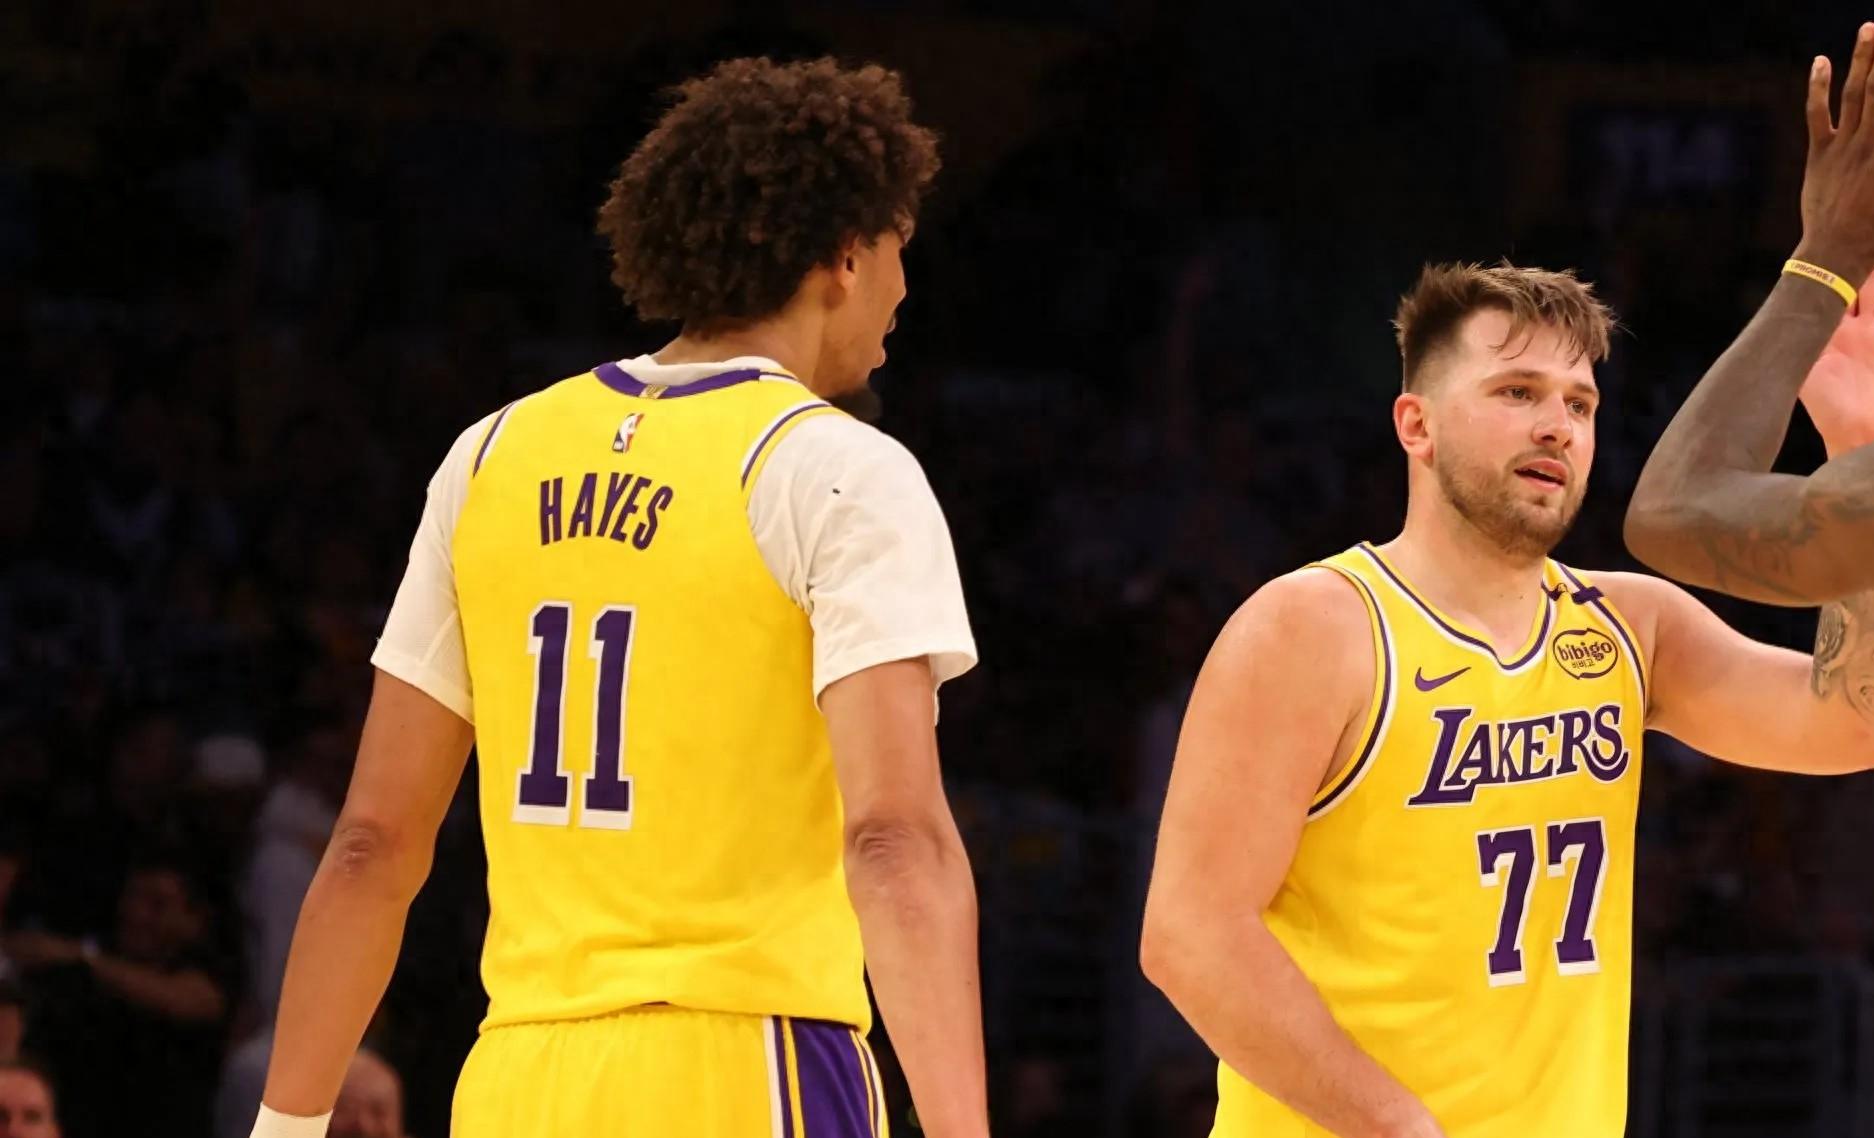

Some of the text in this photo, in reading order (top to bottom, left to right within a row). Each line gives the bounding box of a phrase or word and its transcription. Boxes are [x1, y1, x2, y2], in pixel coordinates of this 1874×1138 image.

[540, 472, 673, 550] HAYES
[1557, 641, 1612, 661] bibigo
[511, 600, 637, 831] 11
[1404, 704, 1630, 807] LAKERS
[1476, 817, 1608, 987] 77
